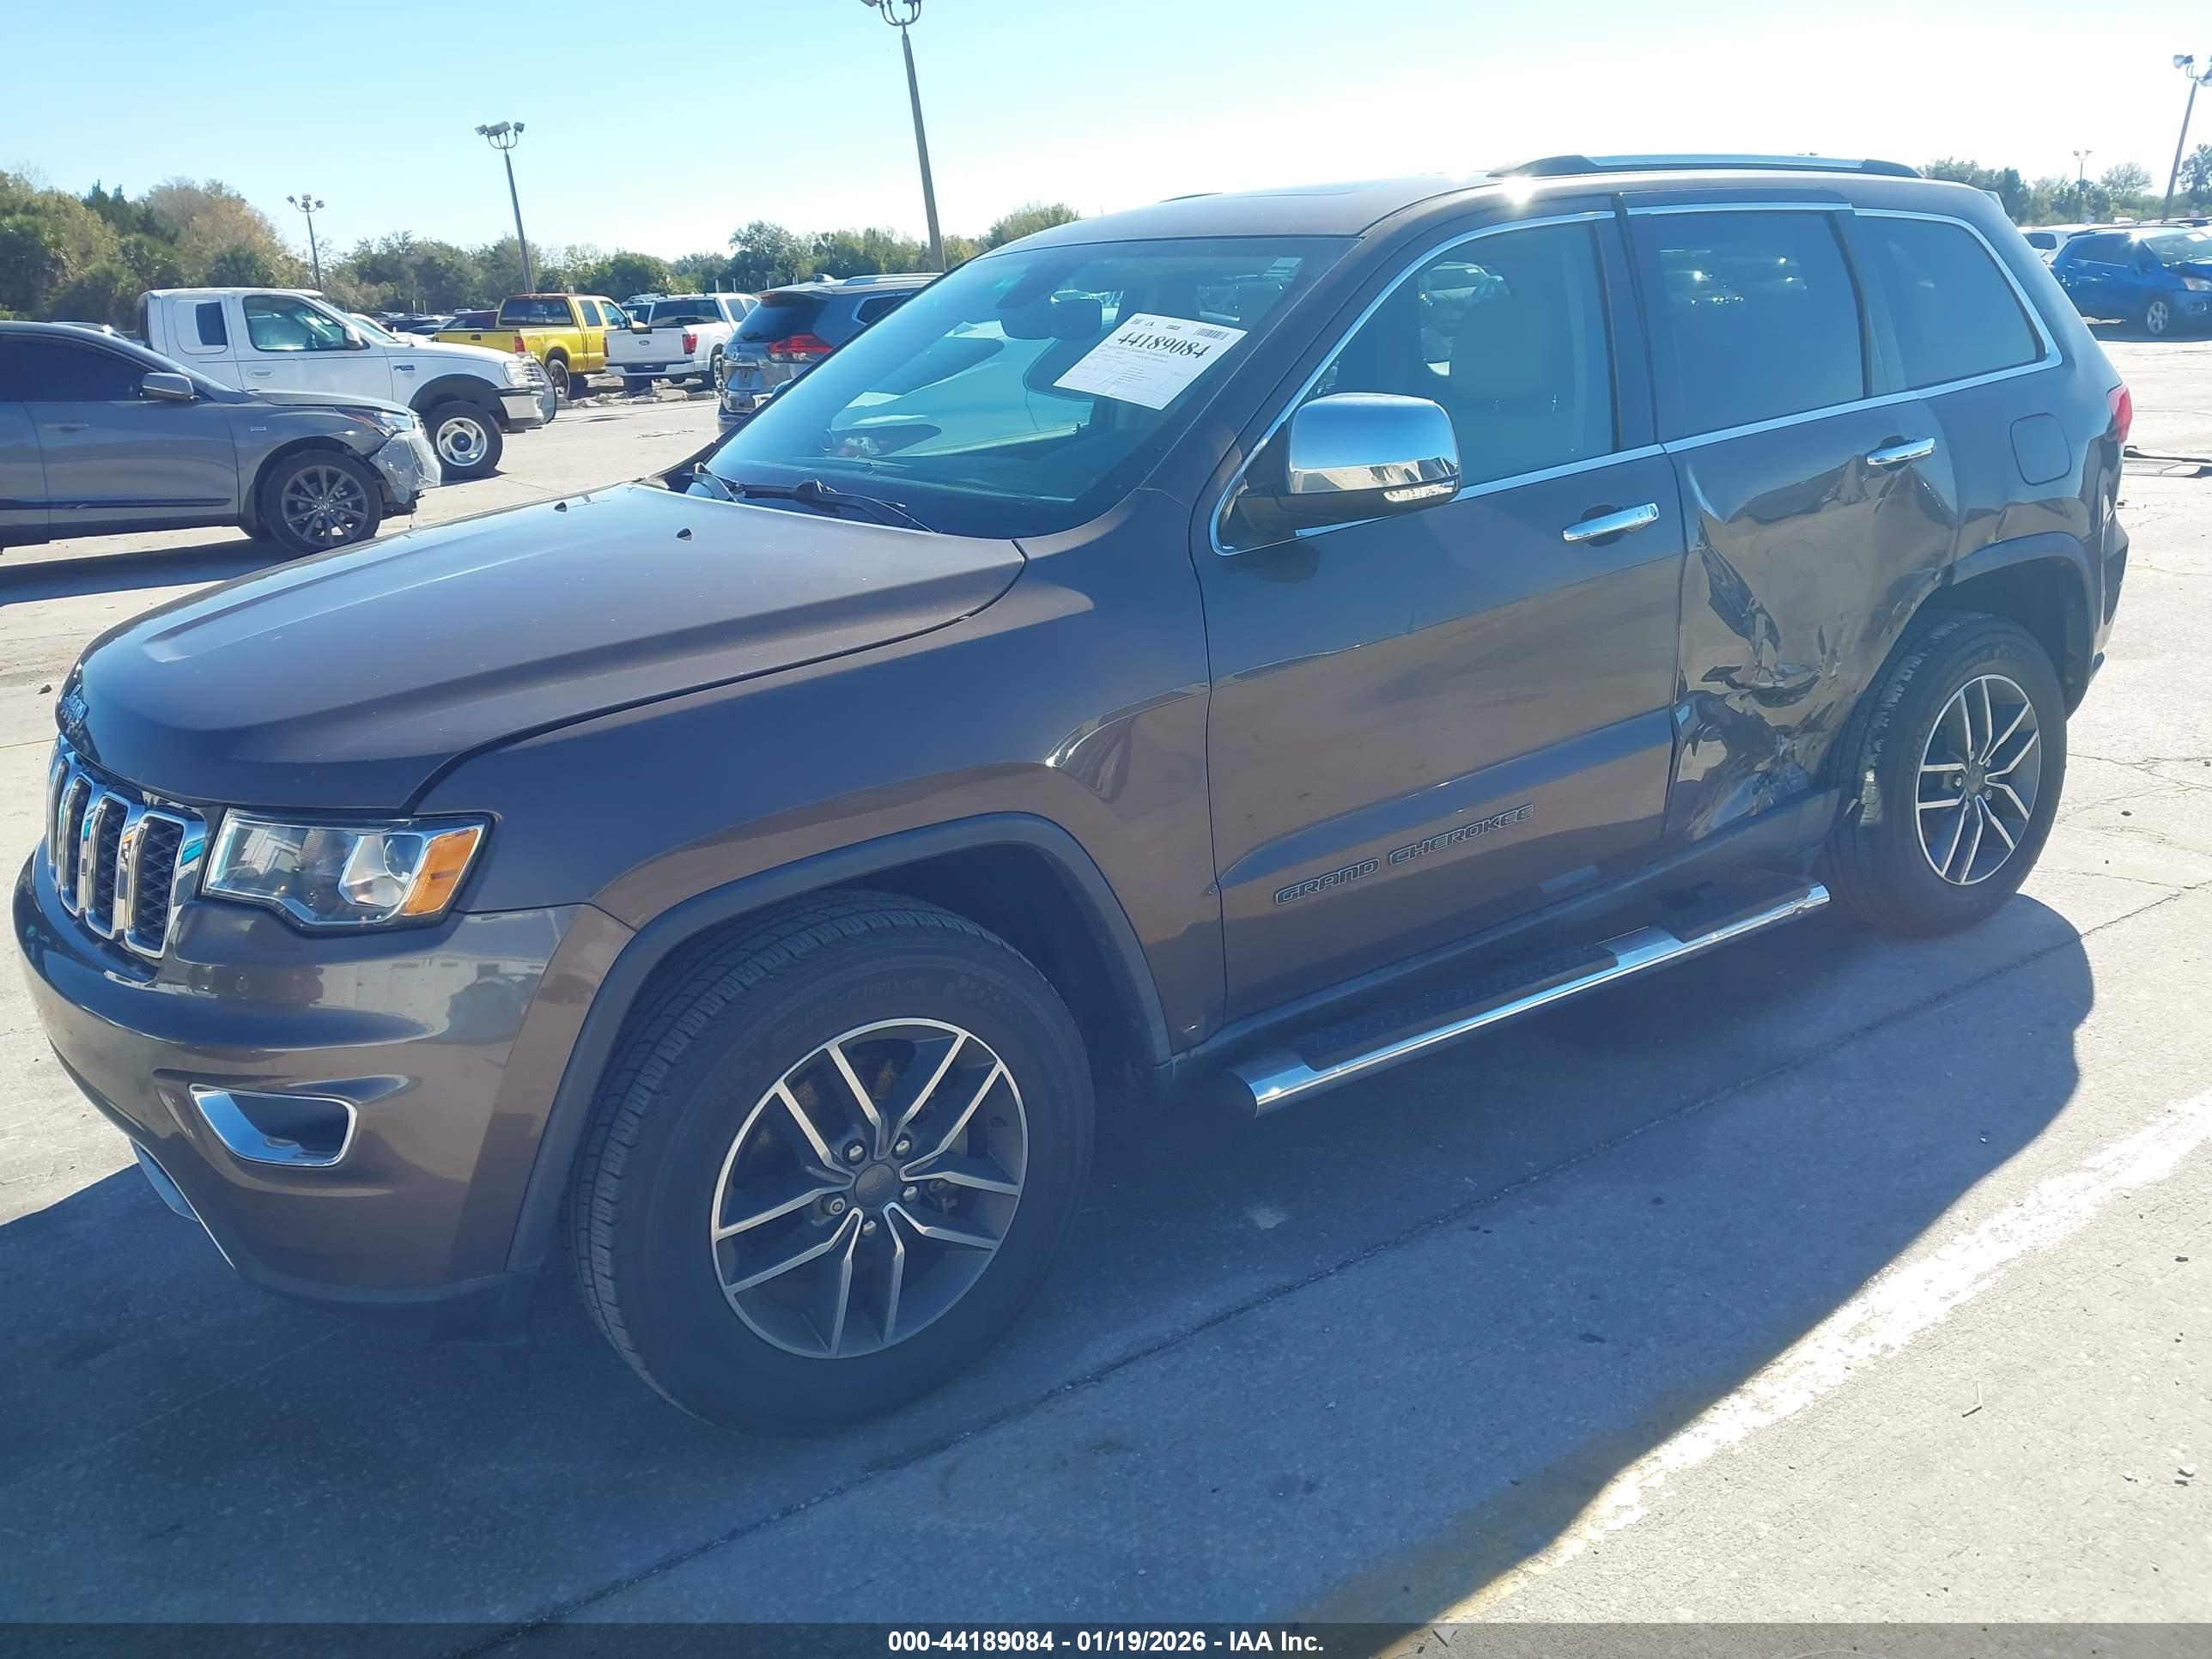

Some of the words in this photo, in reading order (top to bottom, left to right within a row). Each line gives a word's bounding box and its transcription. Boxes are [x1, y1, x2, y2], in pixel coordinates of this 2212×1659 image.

[1117, 331, 1212, 359] 44189084
[1274, 858, 1381, 905] GRAND
[1389, 804, 1535, 866] CHEROKEE
